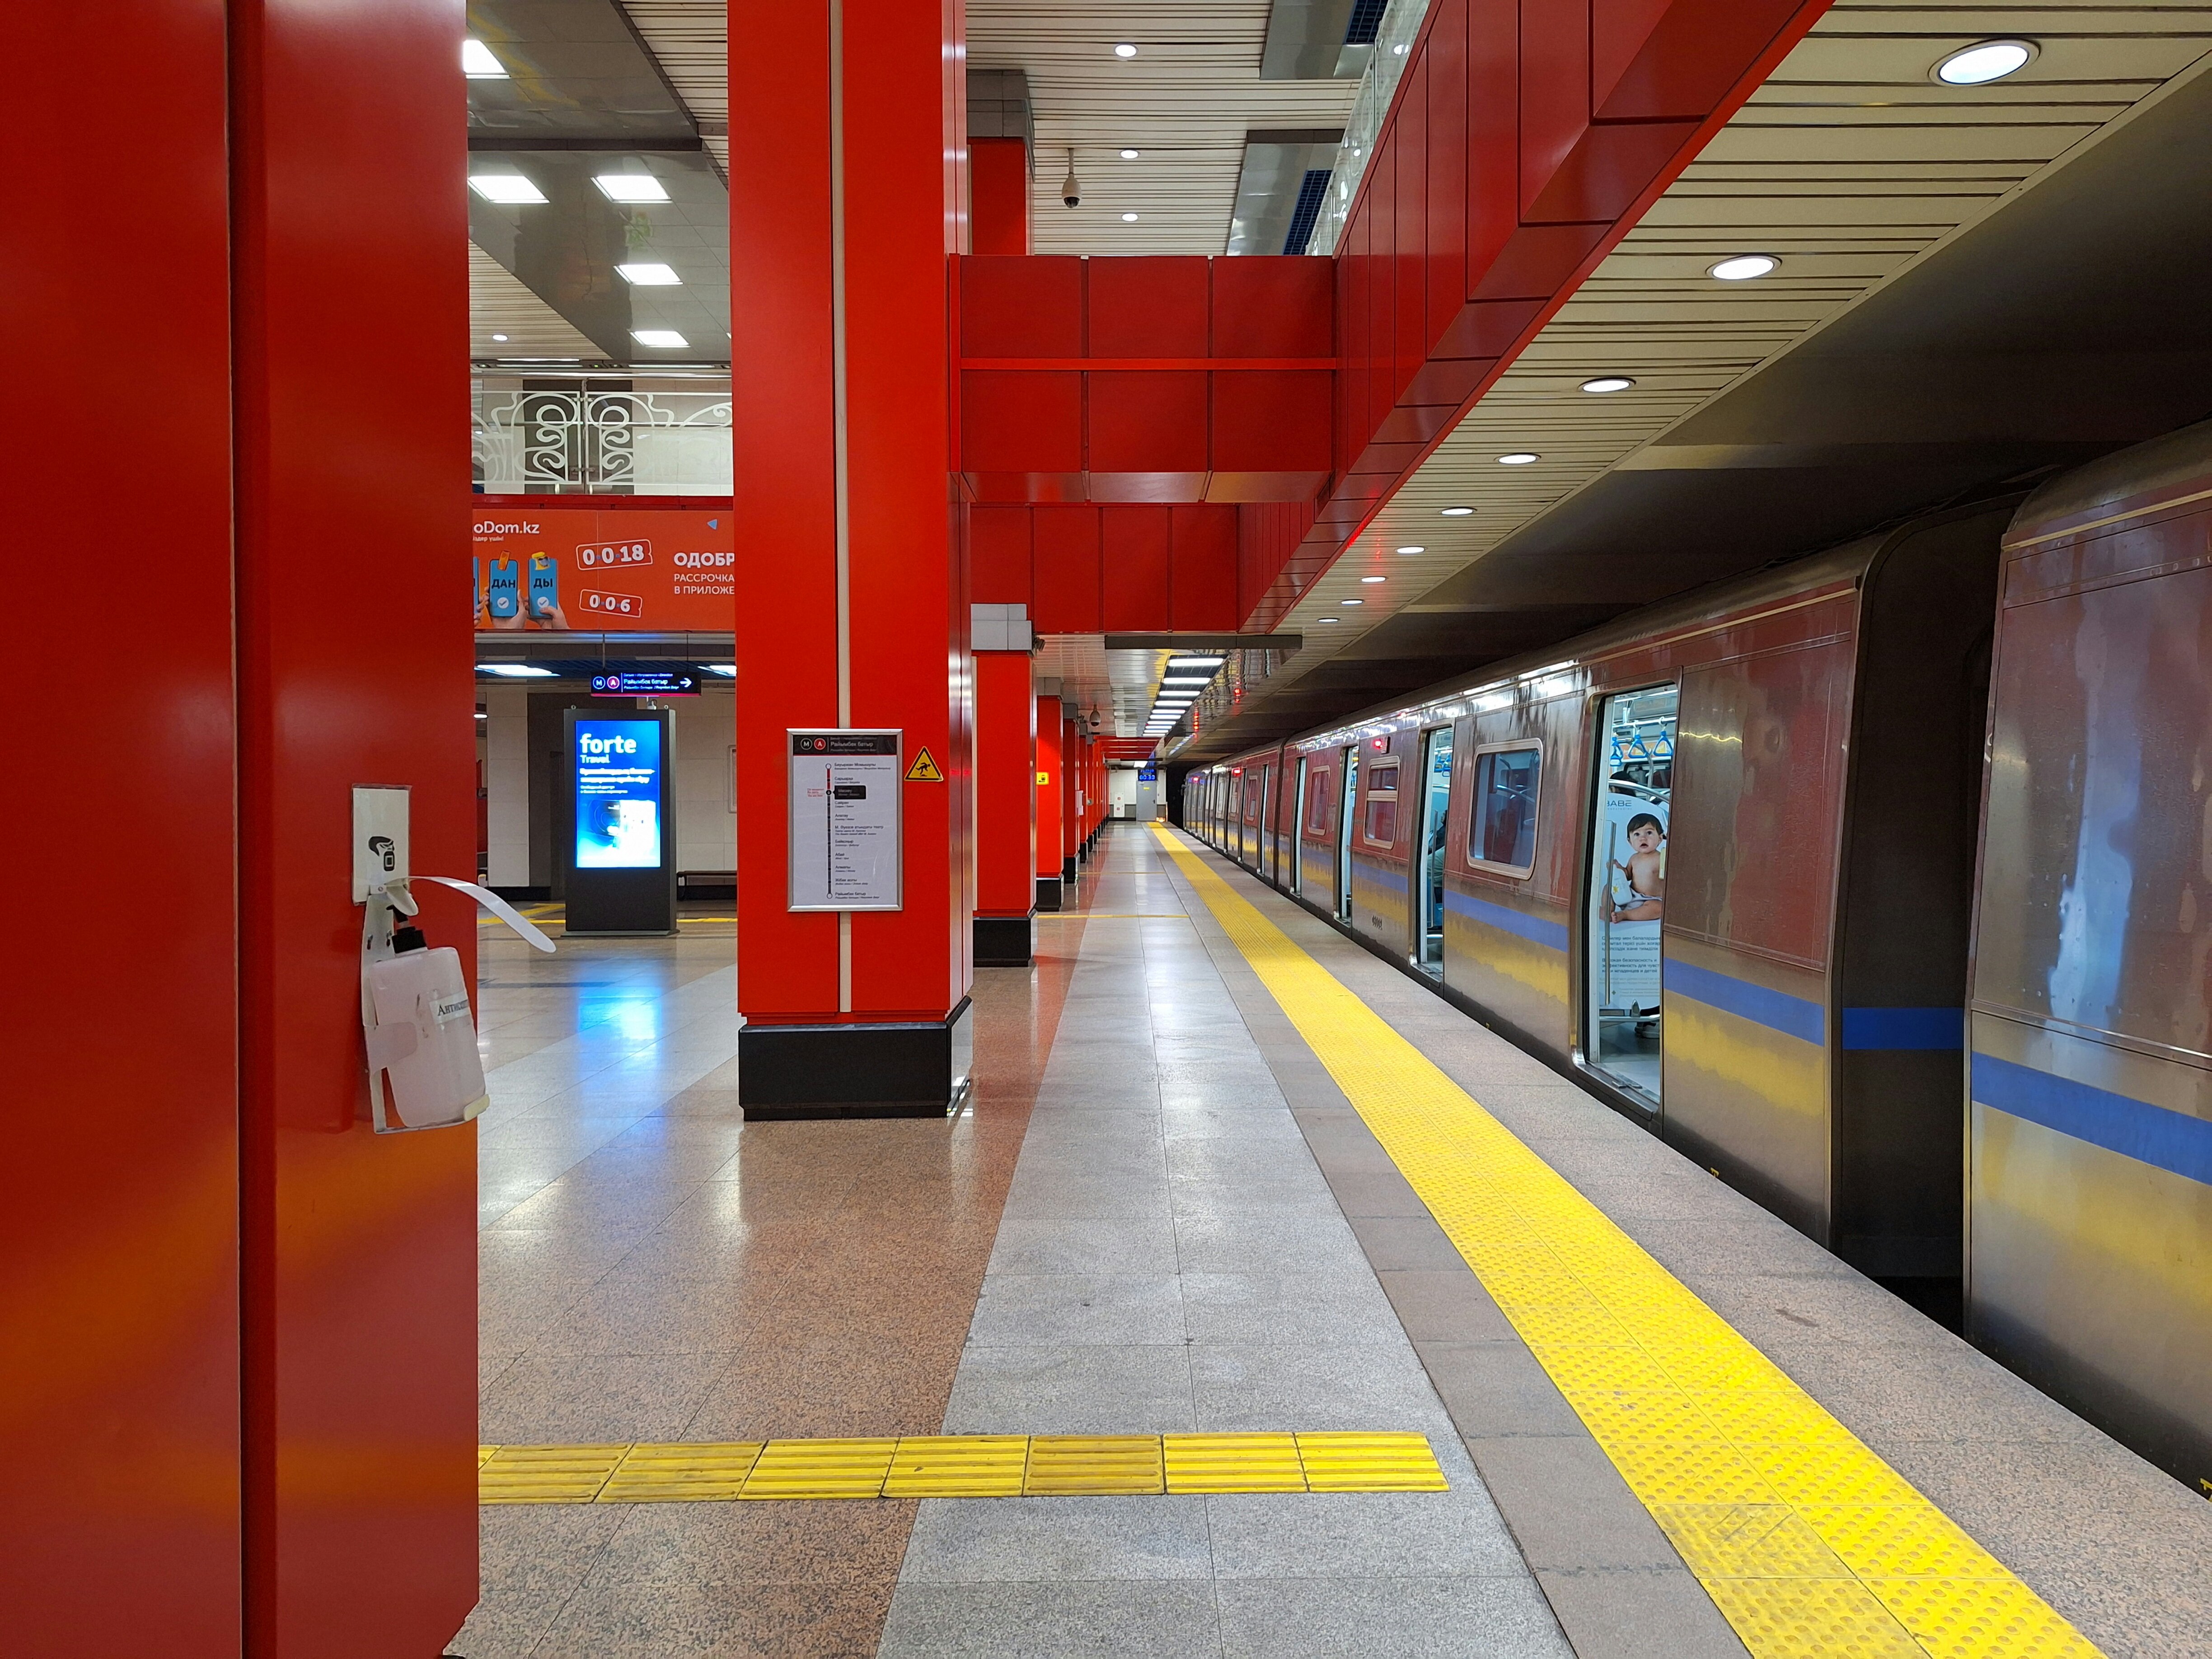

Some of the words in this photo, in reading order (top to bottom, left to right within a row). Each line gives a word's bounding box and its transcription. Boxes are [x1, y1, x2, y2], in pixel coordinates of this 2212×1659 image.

[473, 521, 540, 534] oDom.kz
[674, 553, 735, 568] ОДОБР
[674, 573, 735, 582] РАССРОЧКА
[491, 579, 516, 589] ДАН
[533, 578, 553, 589] ДЫ
[674, 586, 680, 595] В
[683, 586, 735, 595] ПРИЛОЖЕ
[580, 733, 637, 754] forte
[580, 754, 610, 764] Travel
